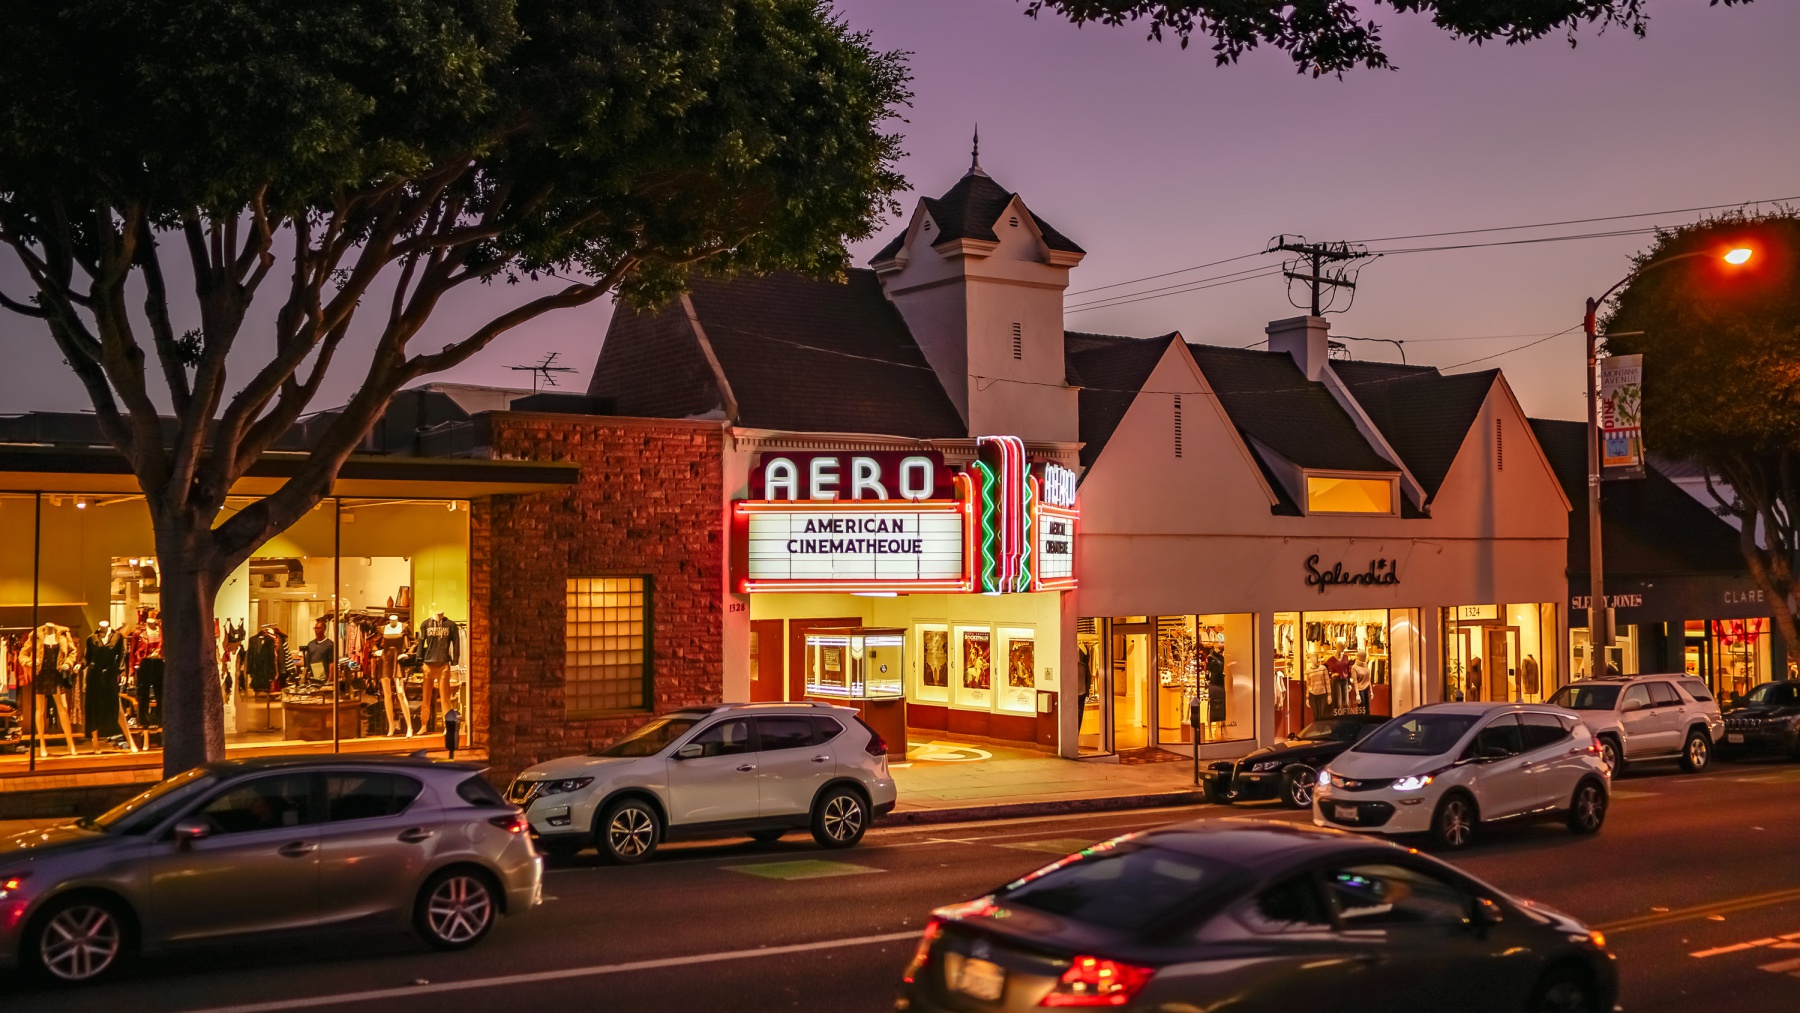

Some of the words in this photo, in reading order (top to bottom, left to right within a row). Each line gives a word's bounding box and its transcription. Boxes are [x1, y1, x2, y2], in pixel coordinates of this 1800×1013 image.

[1604, 368, 1638, 378] MONTANA
[1605, 375, 1637, 384] AVENUE
[1604, 398, 1614, 428] DINE
[765, 456, 934, 501] AERO
[804, 518, 904, 533] AMERICAN
[787, 539, 923, 554] CINEMATHEQUE
[1304, 554, 1400, 594] Splendid
[1571, 595, 1610, 609] SLEY
[1611, 594, 1643, 608] JONES
[1724, 589, 1764, 604] CLARE
[729, 602, 746, 613] 1328
[1465, 606, 1480, 618] 1324
[1333, 706, 1366, 717] SOFTNESS
